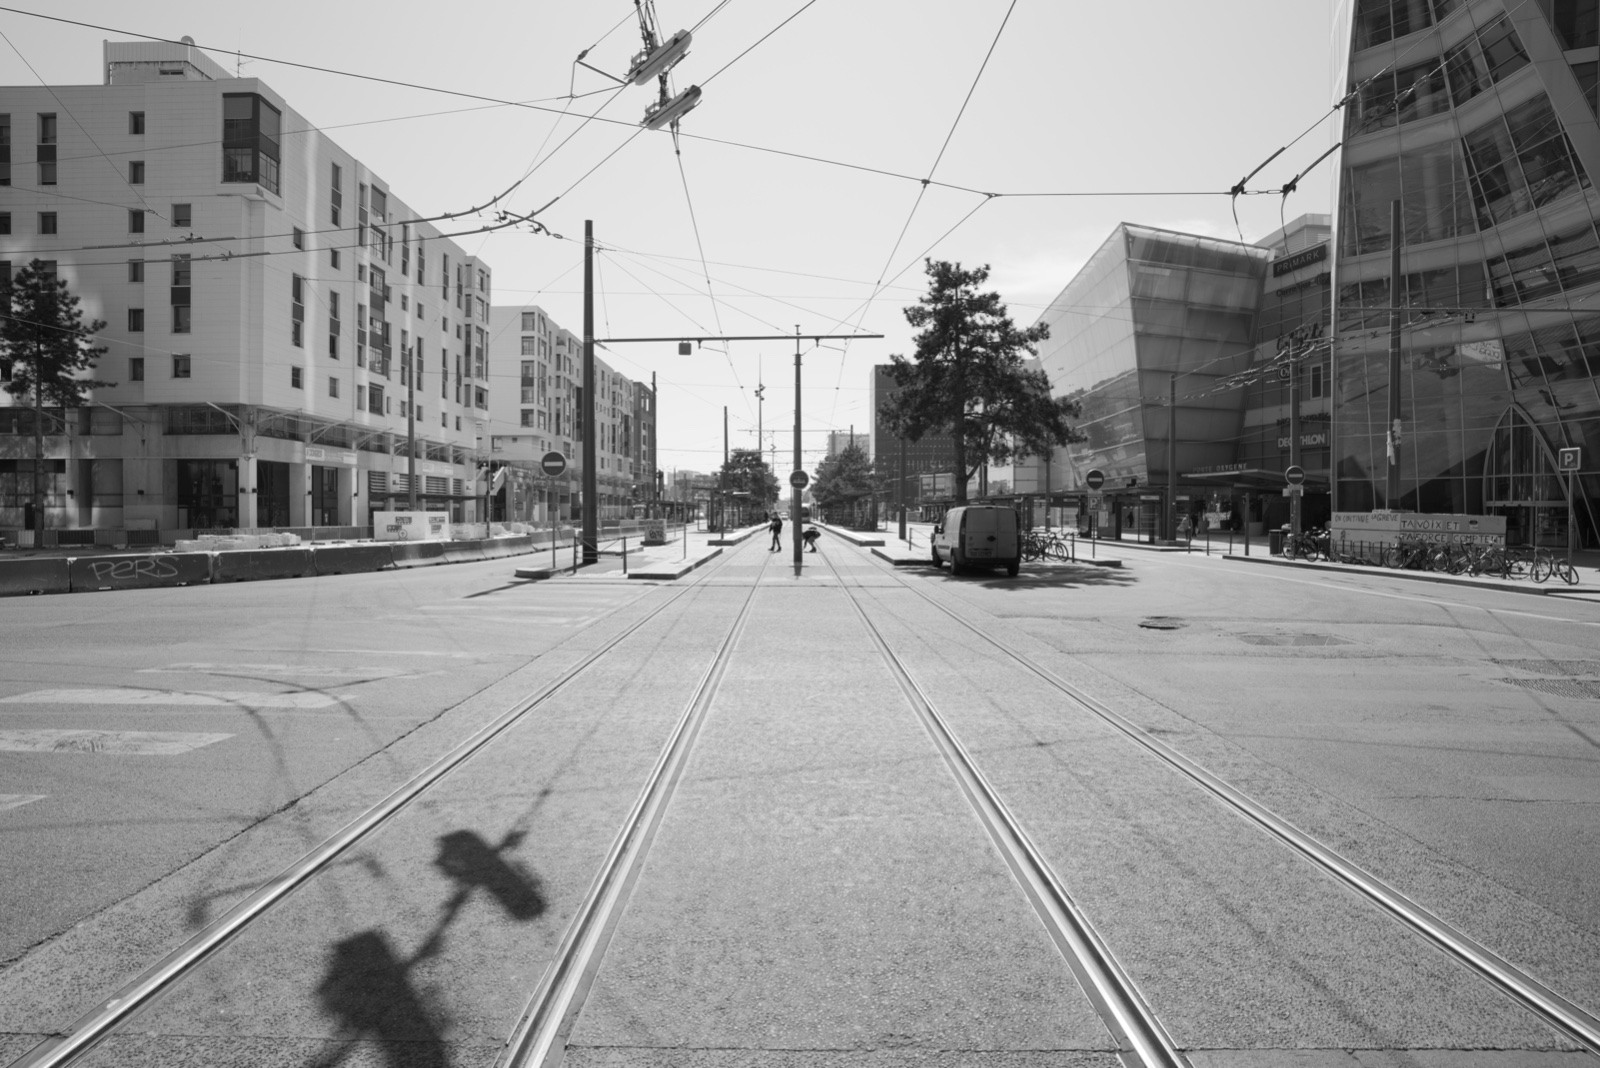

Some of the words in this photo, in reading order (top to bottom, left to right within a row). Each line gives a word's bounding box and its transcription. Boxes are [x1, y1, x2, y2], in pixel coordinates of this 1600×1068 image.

[1276, 250, 1319, 272] PRIMARK
[1565, 453, 1573, 466] P
[1090, 498, 1097, 509] P
[1401, 520, 1415, 529] TA
[1416, 520, 1441, 530] VOIX
[1446, 521, 1460, 531] ET
